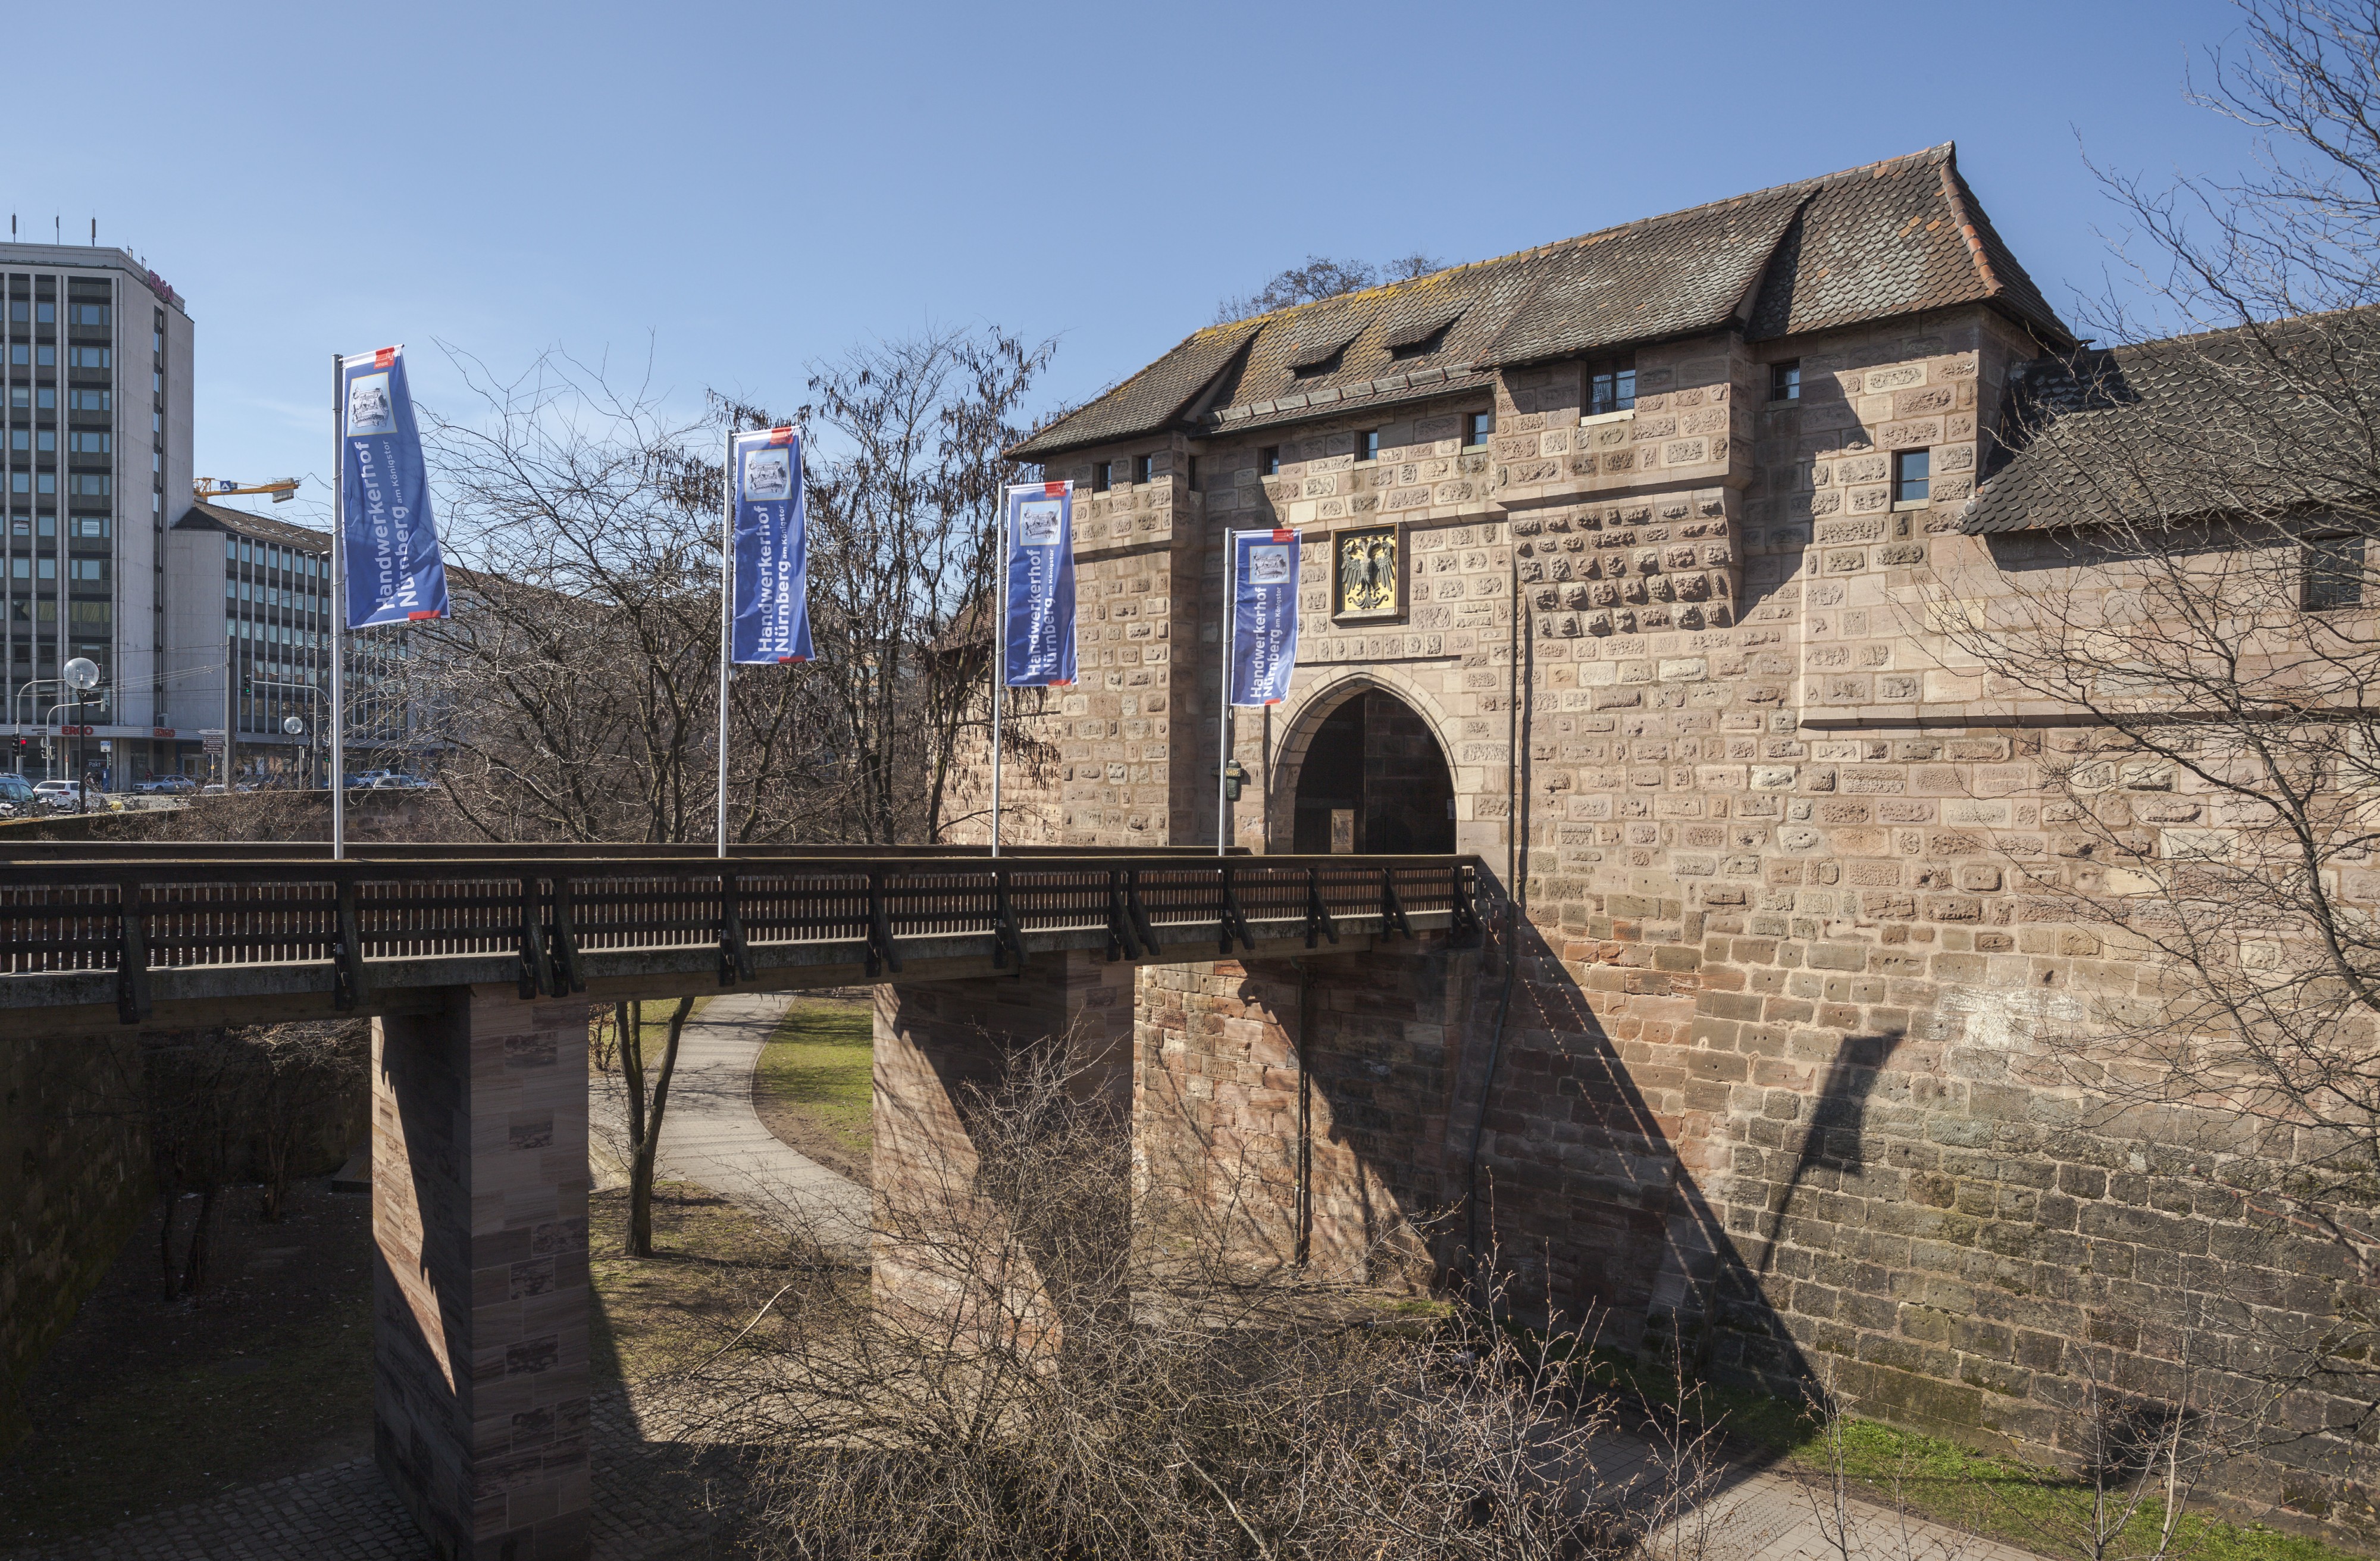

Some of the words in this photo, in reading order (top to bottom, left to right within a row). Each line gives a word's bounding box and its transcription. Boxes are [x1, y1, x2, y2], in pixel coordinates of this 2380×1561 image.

[149, 269, 174, 302] ERGO
[383, 440, 399, 487] Königstor
[395, 489, 403, 503] am
[354, 442, 395, 611] Handwerkerhof
[392, 506, 419, 607] Nürnberg
[779, 505, 787, 545] Königstor
[782, 546, 787, 559] am
[753, 505, 772, 652] Handwerkerhof
[775, 561, 791, 651] Nürnberg
[1026, 549, 1041, 675] Handwerkerhof
[1048, 585, 1053, 596] am
[1042, 598, 1057, 675] Nürnberg
[1250, 587, 1267, 697] Handwerkerhof
[1263, 629, 1283, 697] Nürnberg
[1276, 618, 1280, 628] am
[154, 728, 176, 737] ERGO
